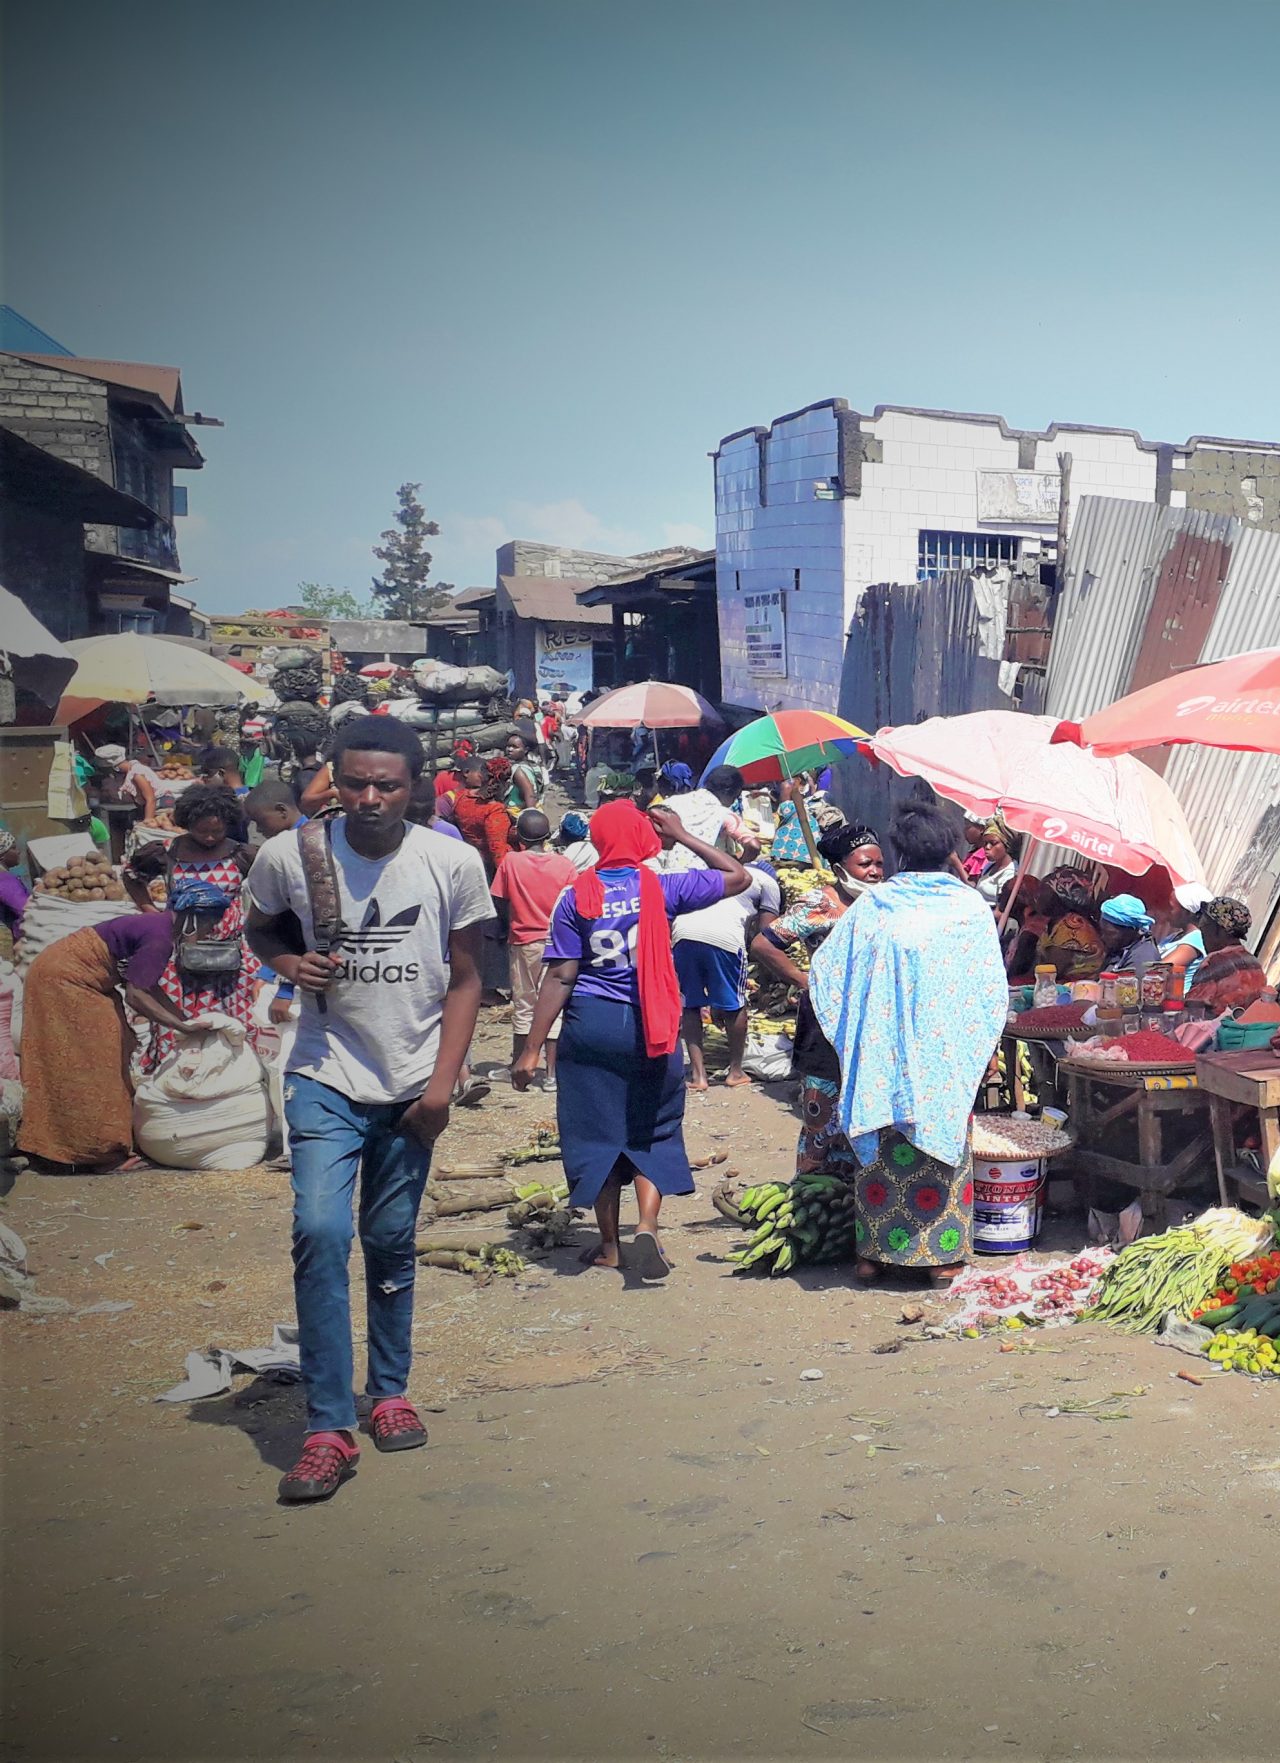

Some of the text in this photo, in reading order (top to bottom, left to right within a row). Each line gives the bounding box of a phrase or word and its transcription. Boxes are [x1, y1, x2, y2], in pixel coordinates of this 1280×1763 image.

[1071, 830, 1115, 858] airtel
[602, 897, 641, 919] ESLE
[334, 959, 420, 984] didas
